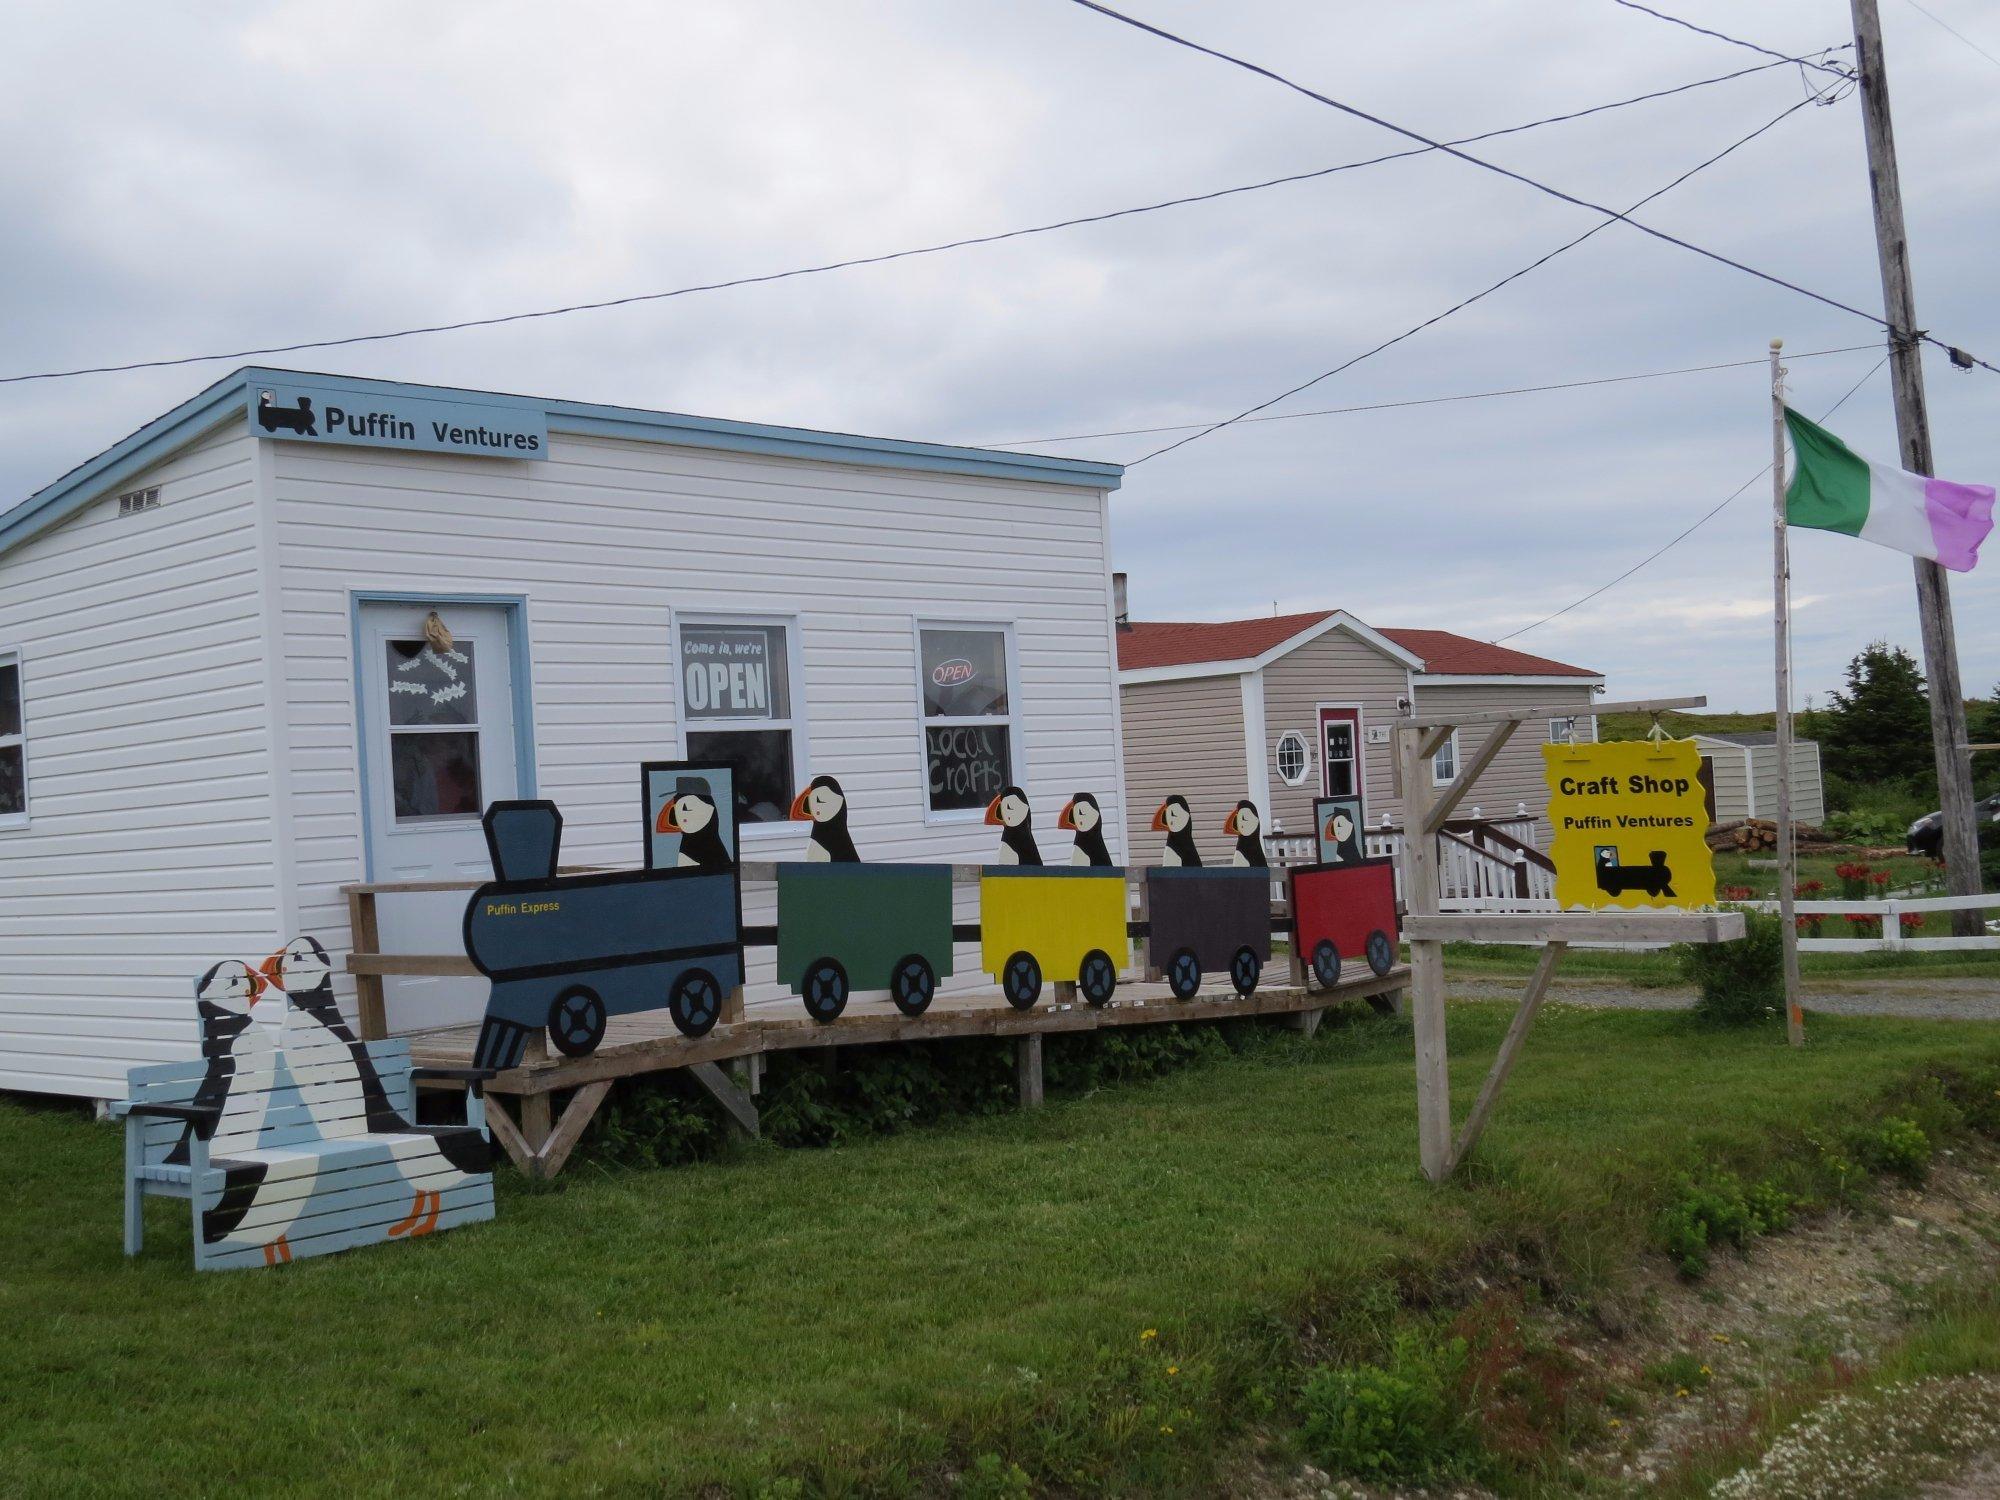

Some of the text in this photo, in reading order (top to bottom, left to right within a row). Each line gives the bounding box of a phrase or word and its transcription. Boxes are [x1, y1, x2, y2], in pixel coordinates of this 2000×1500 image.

[325, 406, 539, 451] Puffin Ventures
[684, 640, 762, 655] Come in, we're
[933, 665, 972, 682] OPEN
[686, 662, 766, 710] OPEN
[929, 759, 1003, 795] Crafts
[1560, 775, 1690, 797] Craft Shop
[1564, 815, 1694, 829] Puffin Ventures
[487, 902, 560, 916] Puffin Express
